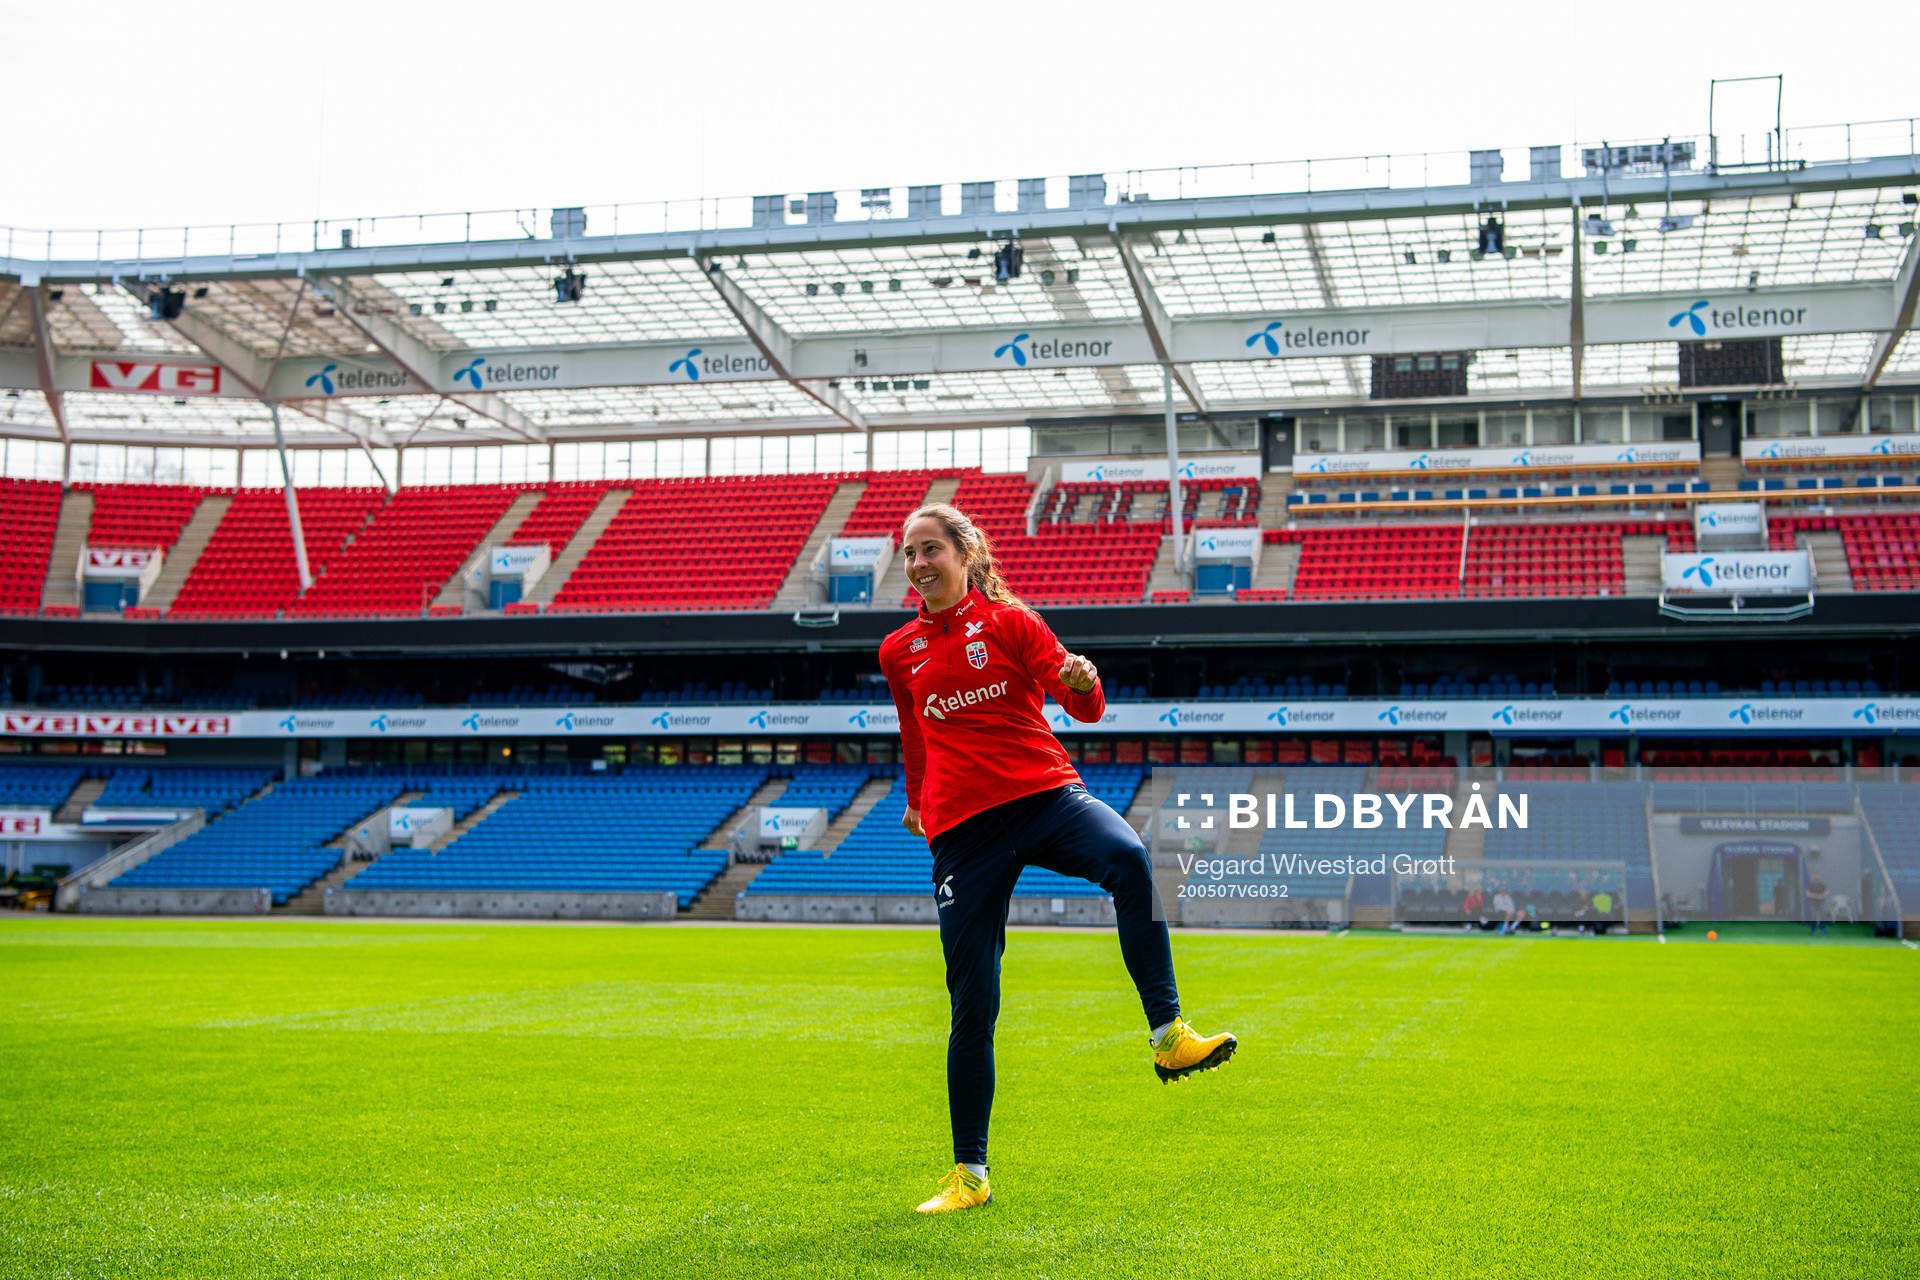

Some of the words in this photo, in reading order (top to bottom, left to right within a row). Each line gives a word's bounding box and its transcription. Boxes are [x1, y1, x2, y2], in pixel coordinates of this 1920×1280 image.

[1712, 305, 1806, 329] telenor
[1284, 327, 1370, 349] telenor
[1031, 338, 1112, 360] telenor
[704, 353, 770, 374] teleno
[93, 361, 220, 392] VG
[487, 361, 560, 384] telenor
[1635, 449, 1680, 461] telenor
[1780, 444, 1826, 457] telenor
[1328, 458, 1370, 470] telenor
[1428, 455, 1471, 467] telenor
[1530, 452, 1574, 464] telenor
[1104, 466, 1144, 478] telenor
[1194, 463, 1236, 475] telenor
[1718, 511, 1758, 523] telenor
[1715, 561, 1791, 580] telenor
[938, 680, 1008, 712] telenor
[574, 714, 614, 727] telenor
[670, 713, 711, 726] telenor
[767, 713, 809, 726] telenor
[866, 712, 898, 725] telen
[1178, 710, 1224, 724] telenor
[1288, 709, 1334, 723] telenor
[1399, 708, 1446, 722] telenor
[1513, 708, 1562, 722] telenor
[1630, 708, 1680, 721] telenor
[1751, 707, 1804, 721] telenor
[6, 716, 77, 734] VG
[85, 716, 156, 735] VG
[162, 716, 230, 735] VG
[296, 717, 334, 729] telenor
[388, 716, 426, 728] telenor
[480, 715, 519, 727] telenor
